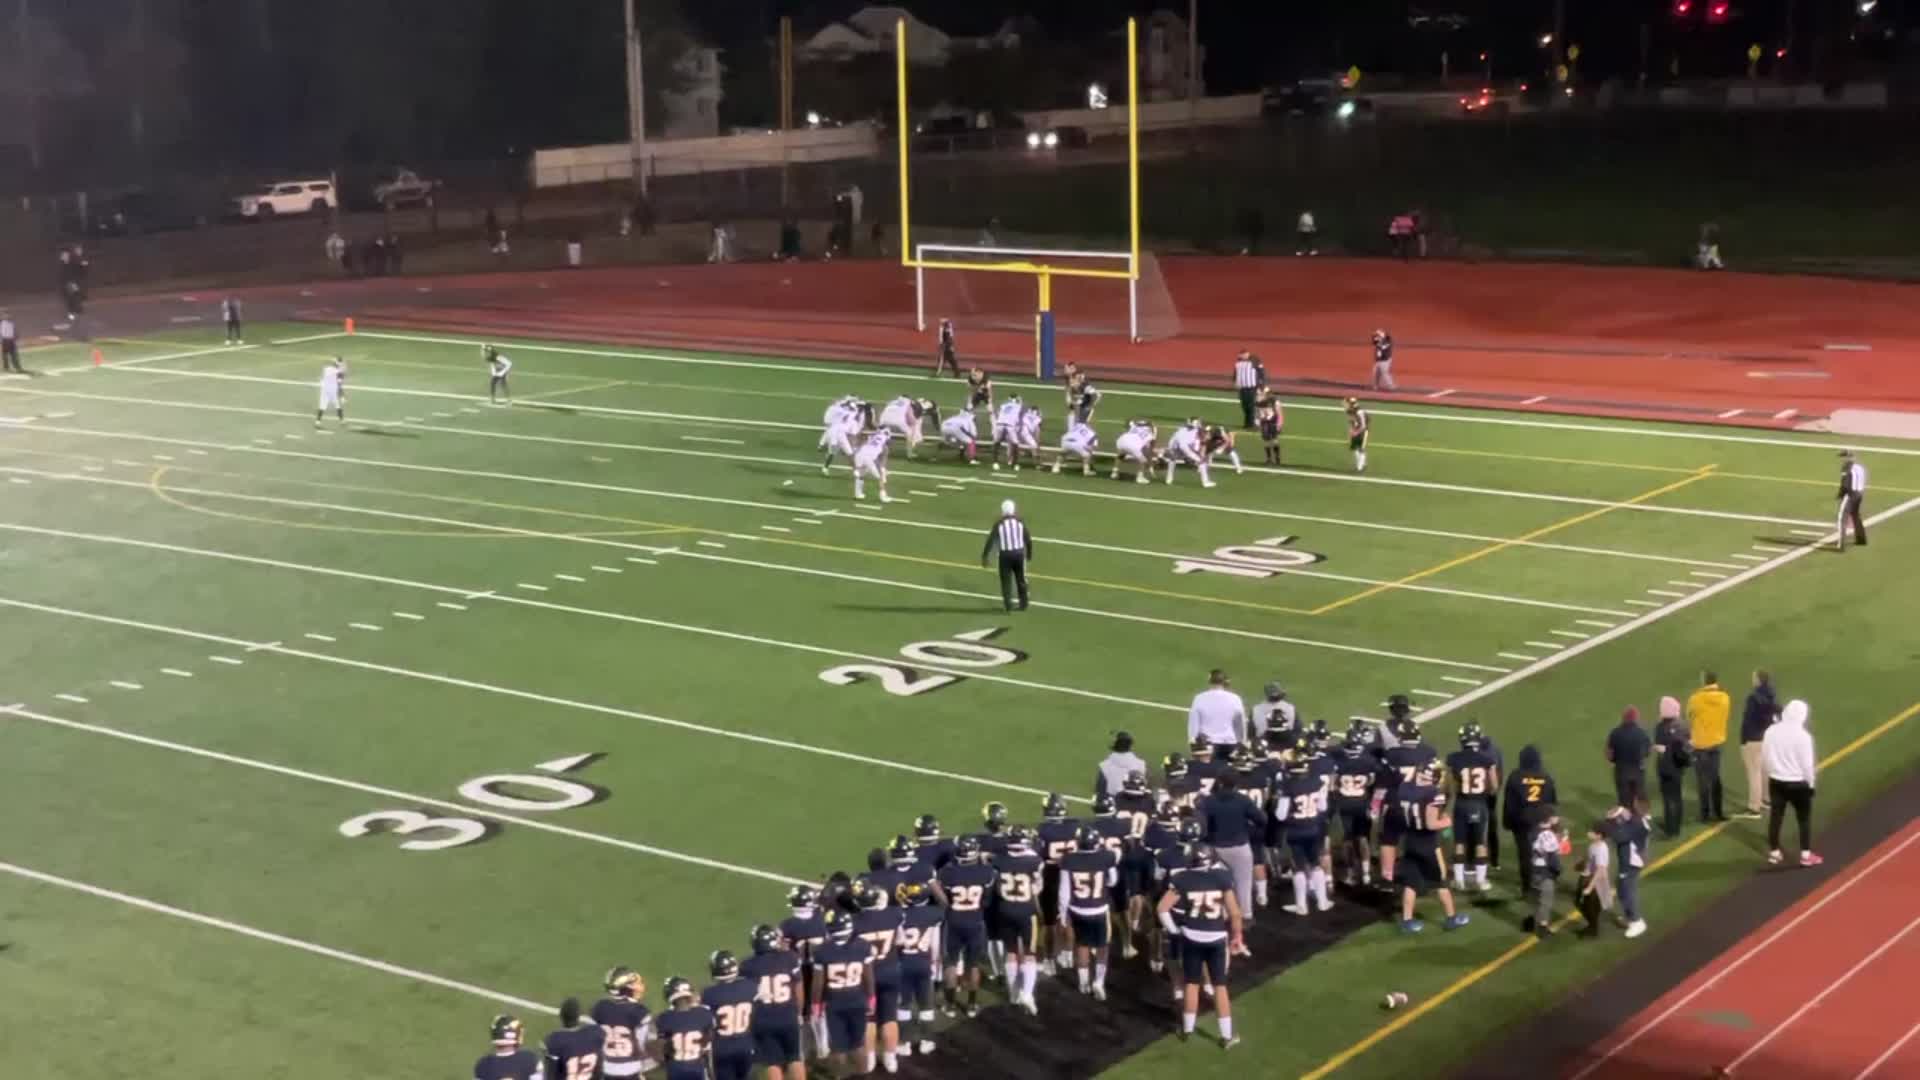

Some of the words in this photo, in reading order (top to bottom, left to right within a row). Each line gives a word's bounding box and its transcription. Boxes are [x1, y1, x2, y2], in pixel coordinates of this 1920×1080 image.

[1172, 546, 1318, 578] 10
[818, 641, 1017, 696] 20
[1461, 767, 1486, 794] 13
[1527, 785, 1541, 802] 2
[339, 774, 594, 850] 30
[1400, 801, 1423, 830] 71
[951, 885, 983, 911] 29
[1000, 871, 1031, 902] 23
[1072, 871, 1104, 899] 51
[1187, 891, 1222, 919] 75
[755, 973, 791, 1004] 46
[827, 961, 863, 989] 58
[717, 1002, 753, 1036] 30
[566, 1053, 598, 1080] 12
